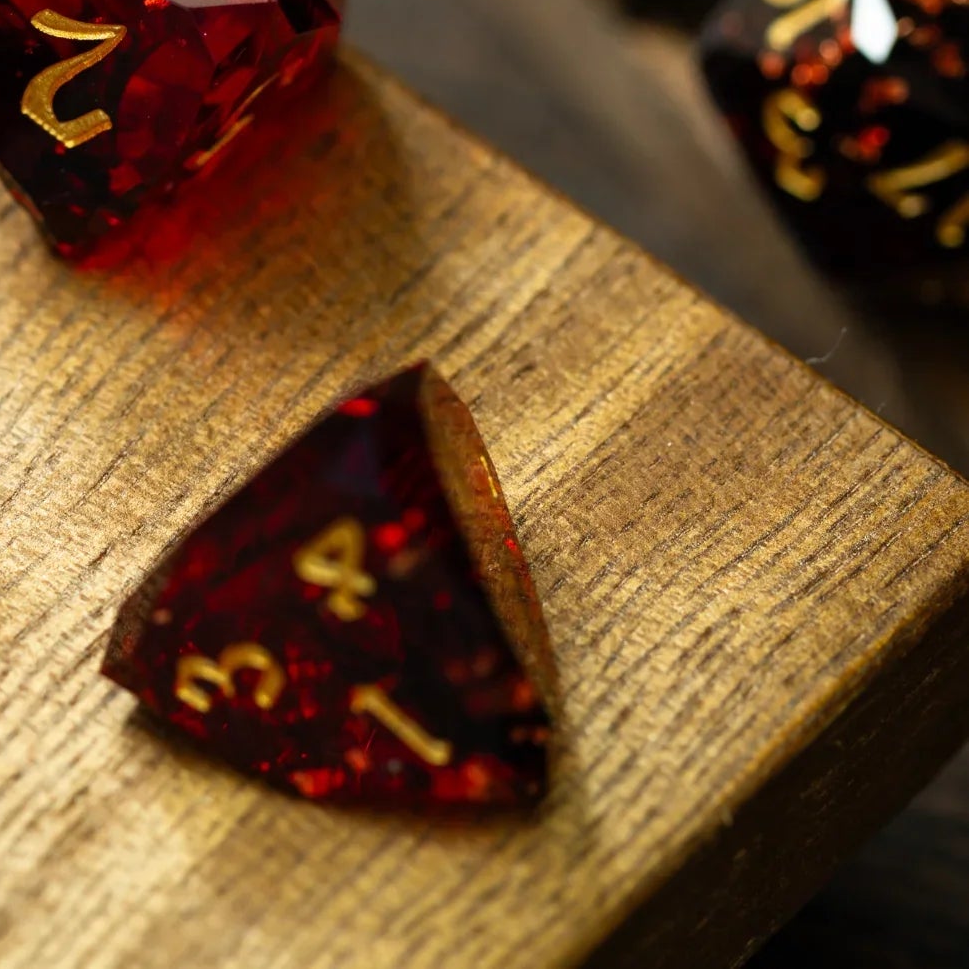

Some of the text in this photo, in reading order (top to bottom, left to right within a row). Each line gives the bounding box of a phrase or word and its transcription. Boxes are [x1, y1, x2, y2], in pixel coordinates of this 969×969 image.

[19, 7, 128, 149] 2
[761, 86, 827, 203] 3
[293, 515, 377, 623] 4
[175, 640, 287, 716] 3
[349, 683, 453, 768] 1
